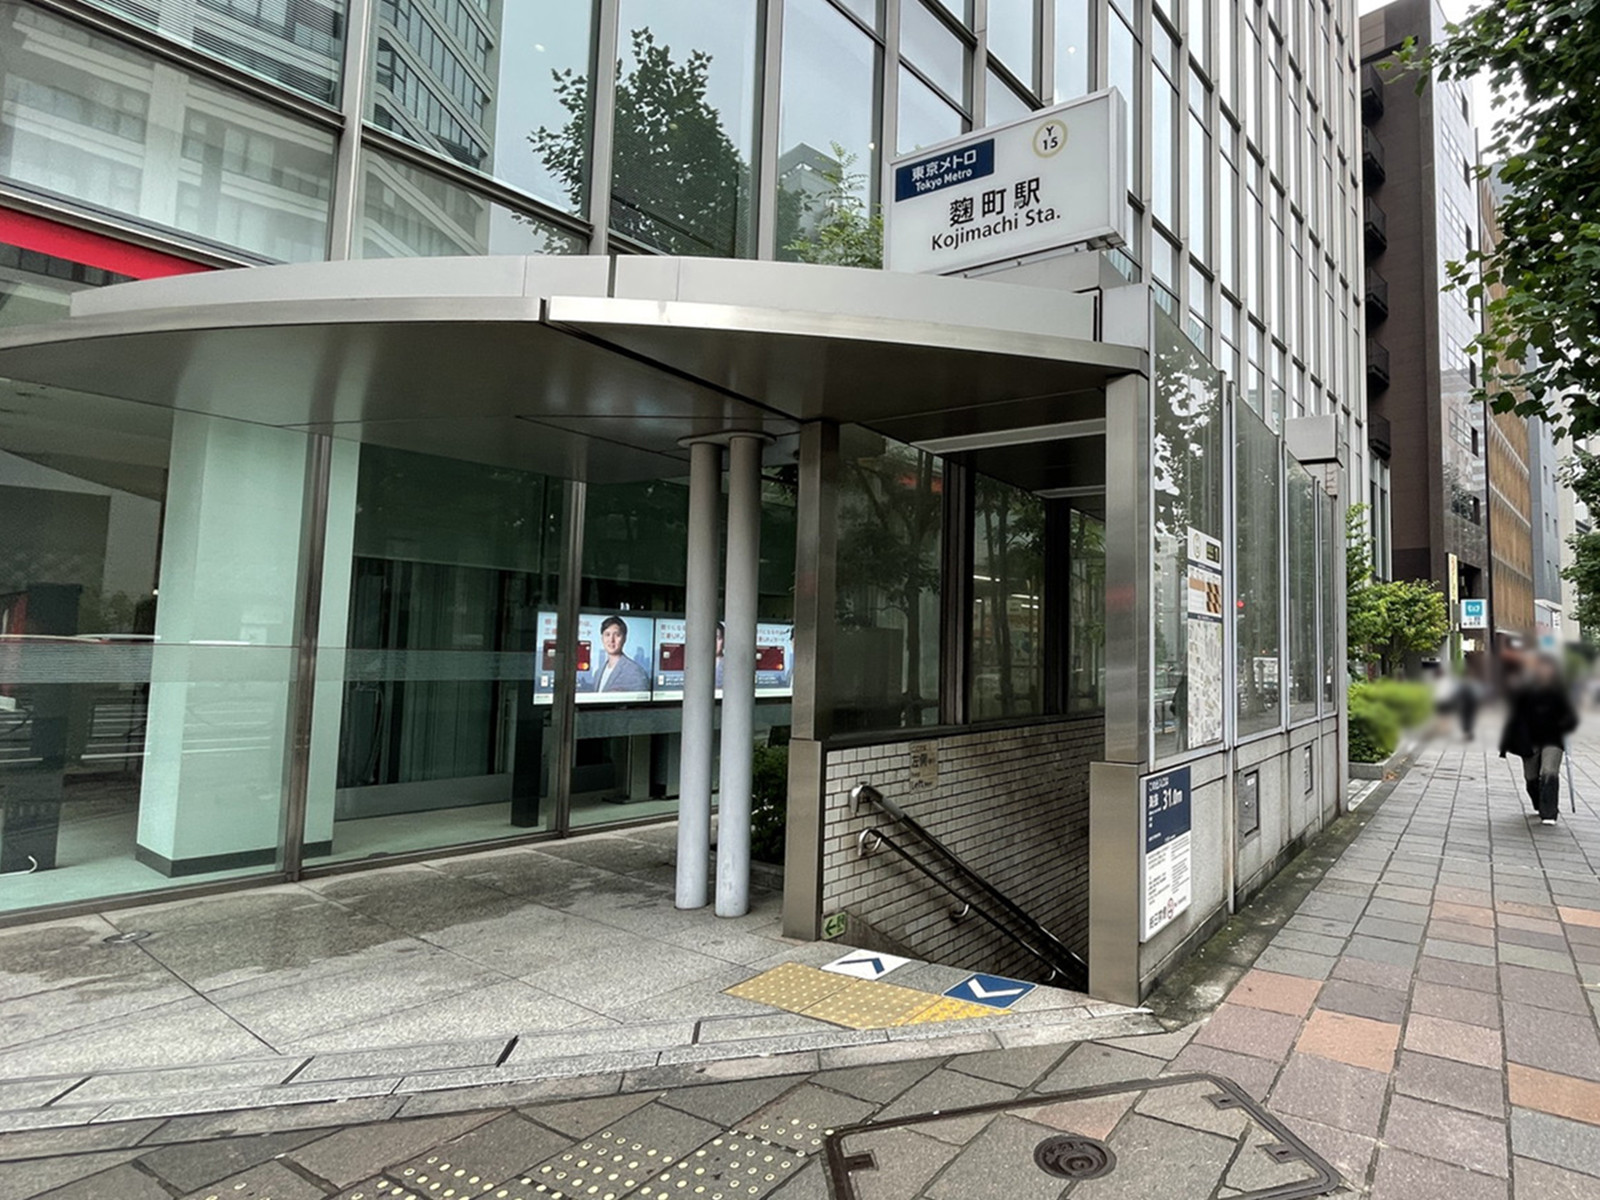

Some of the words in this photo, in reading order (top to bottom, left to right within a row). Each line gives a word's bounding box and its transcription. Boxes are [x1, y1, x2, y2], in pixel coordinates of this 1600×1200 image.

[1046, 126, 1055, 137] Y
[1042, 137, 1059, 151] 15
[911, 149, 977, 182] 東京メトロ
[915, 177, 943, 193] Tokyo
[943, 168, 973, 185] Metro
[931, 212, 1019, 251] Kojimachi
[1025, 207, 1061, 227] Sta.
[1162, 788, 1183, 811] 31.0m
